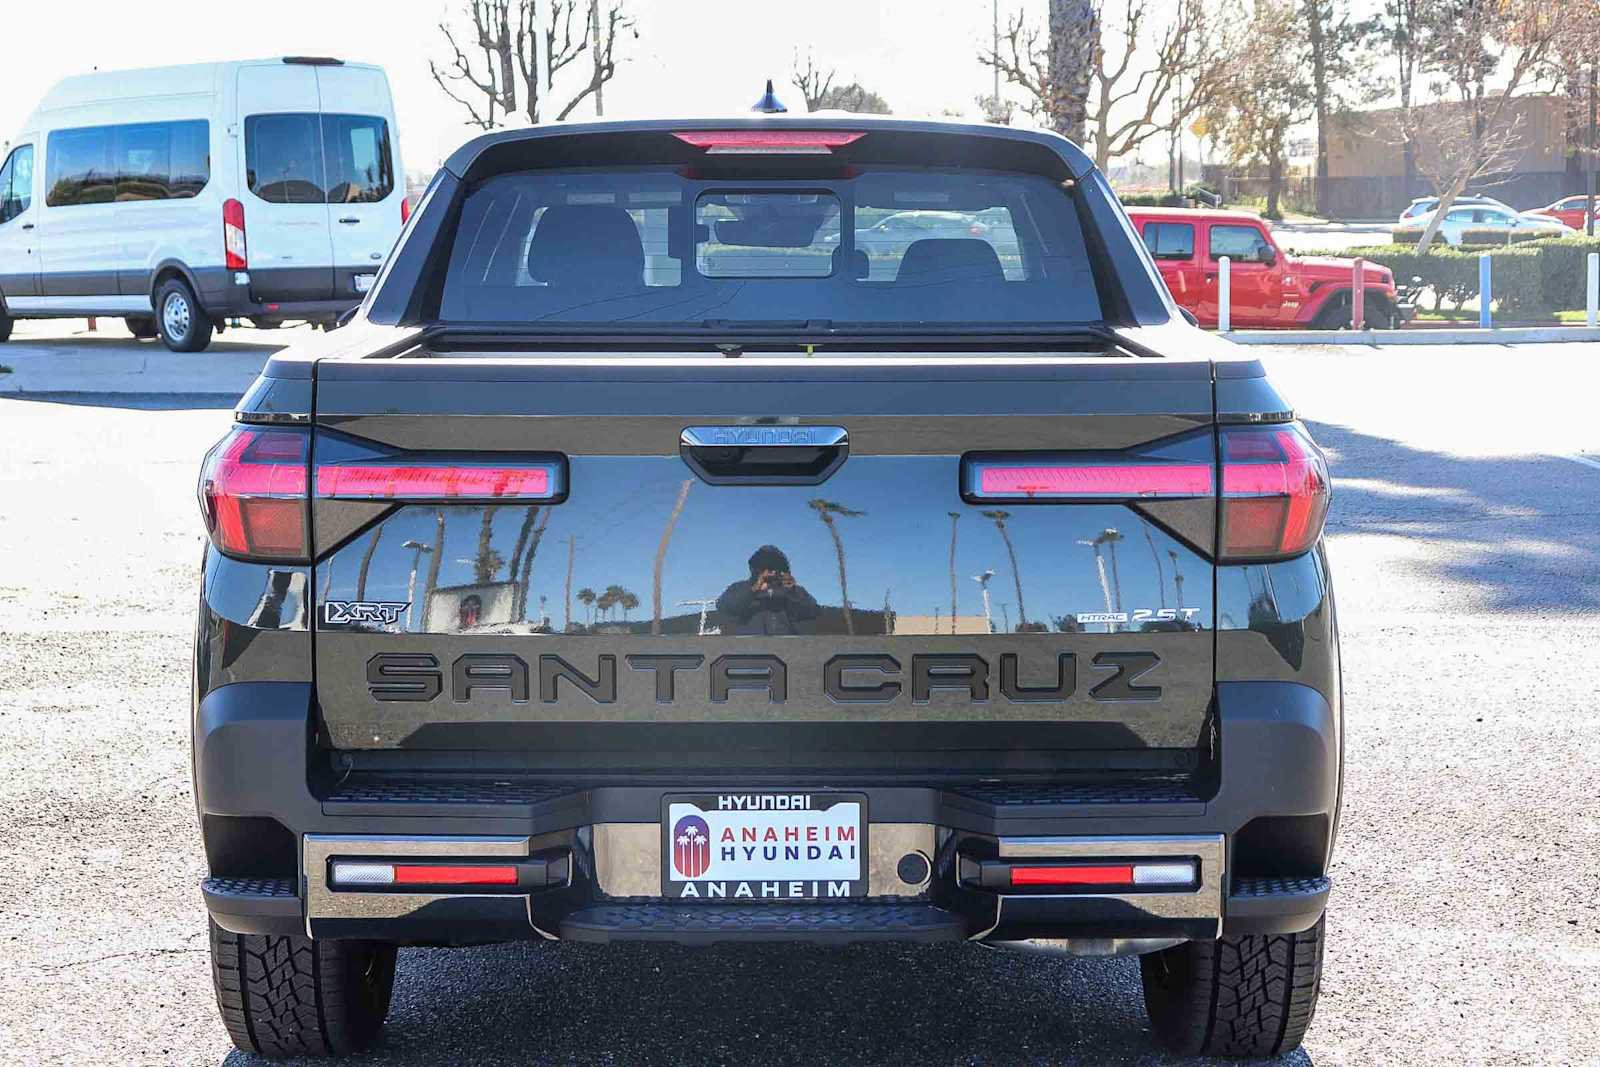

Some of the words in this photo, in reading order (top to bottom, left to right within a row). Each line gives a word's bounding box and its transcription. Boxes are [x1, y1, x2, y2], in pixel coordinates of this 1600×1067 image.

[713, 428, 816, 445] HYUNDAI
[326, 601, 411, 624] XRT
[366, 652, 788, 703] SANTA
[823, 652, 1163, 703] CRUZ
[718, 795, 811, 810] HYUNDAI
[721, 826, 856, 842] ANAHEIM
[721, 845, 856, 861] HYUNDAI
[680, 881, 851, 898] ANAHEIM
